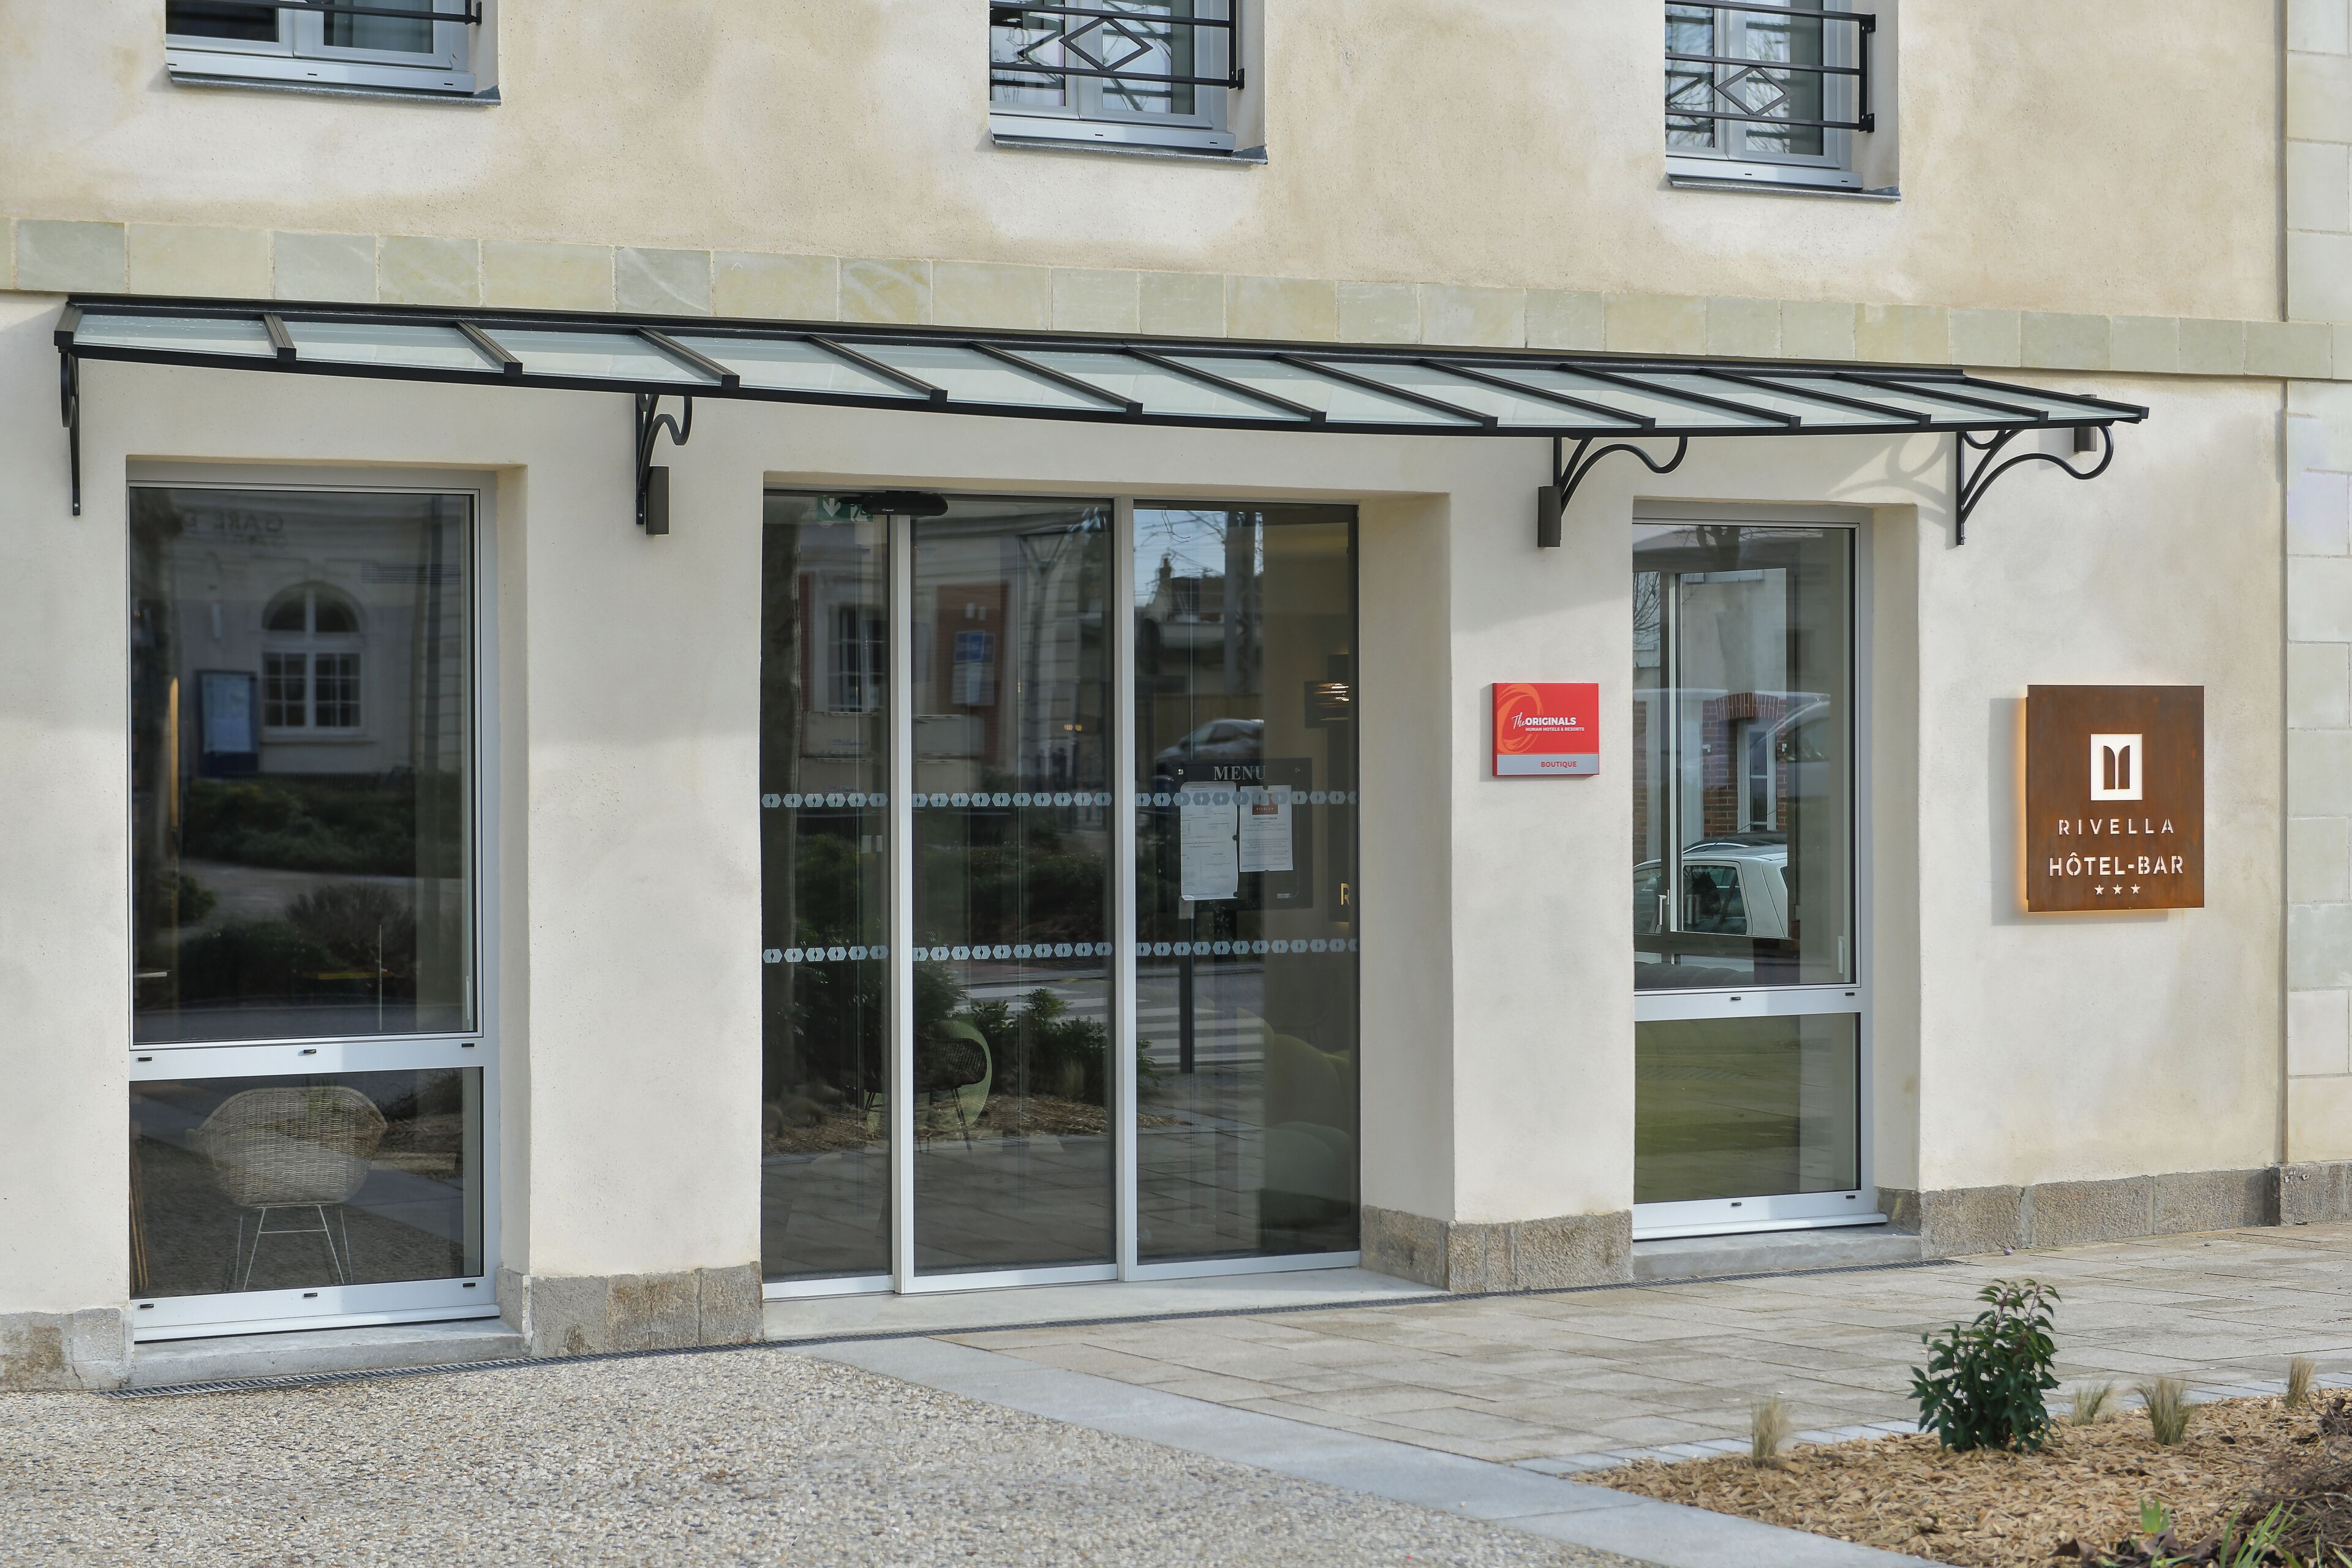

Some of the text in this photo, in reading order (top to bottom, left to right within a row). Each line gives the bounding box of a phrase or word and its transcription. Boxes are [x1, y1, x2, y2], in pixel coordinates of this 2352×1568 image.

[1511, 712, 1526, 729] The
[1214, 766, 1266, 780] MENU
[2059, 818, 2174, 835] RIVELLA
[2049, 852, 2184, 876] HÔTEL-BAR
